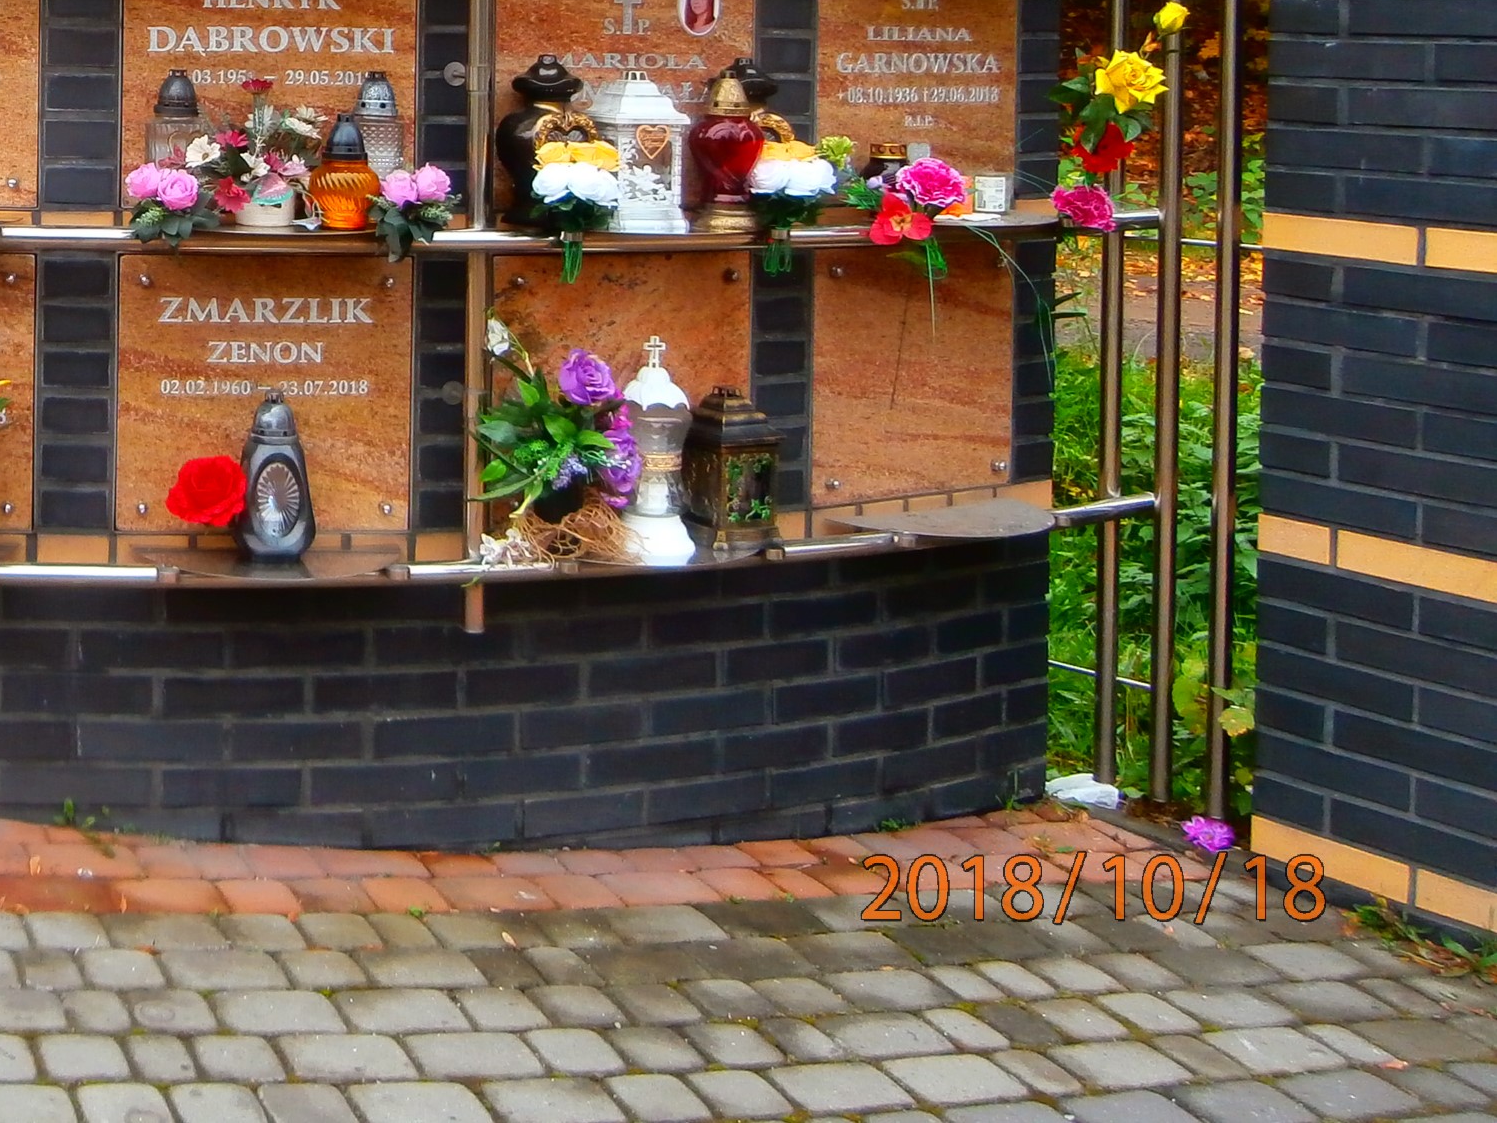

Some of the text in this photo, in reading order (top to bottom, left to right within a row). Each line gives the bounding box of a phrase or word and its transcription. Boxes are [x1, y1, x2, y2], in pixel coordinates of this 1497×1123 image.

[147, 26, 394, 57] DĄBROWSKI
[867, 26, 973, 41] LILIANA
[836, 53, 1000, 74] GARNOWSKA
[158, 297, 373, 323] ZMARZLIK
[207, 341, 324, 363] ZENON
[160, 380, 251, 395] 02.02.1960
[280, 380, 369, 395] 23.07.2018
